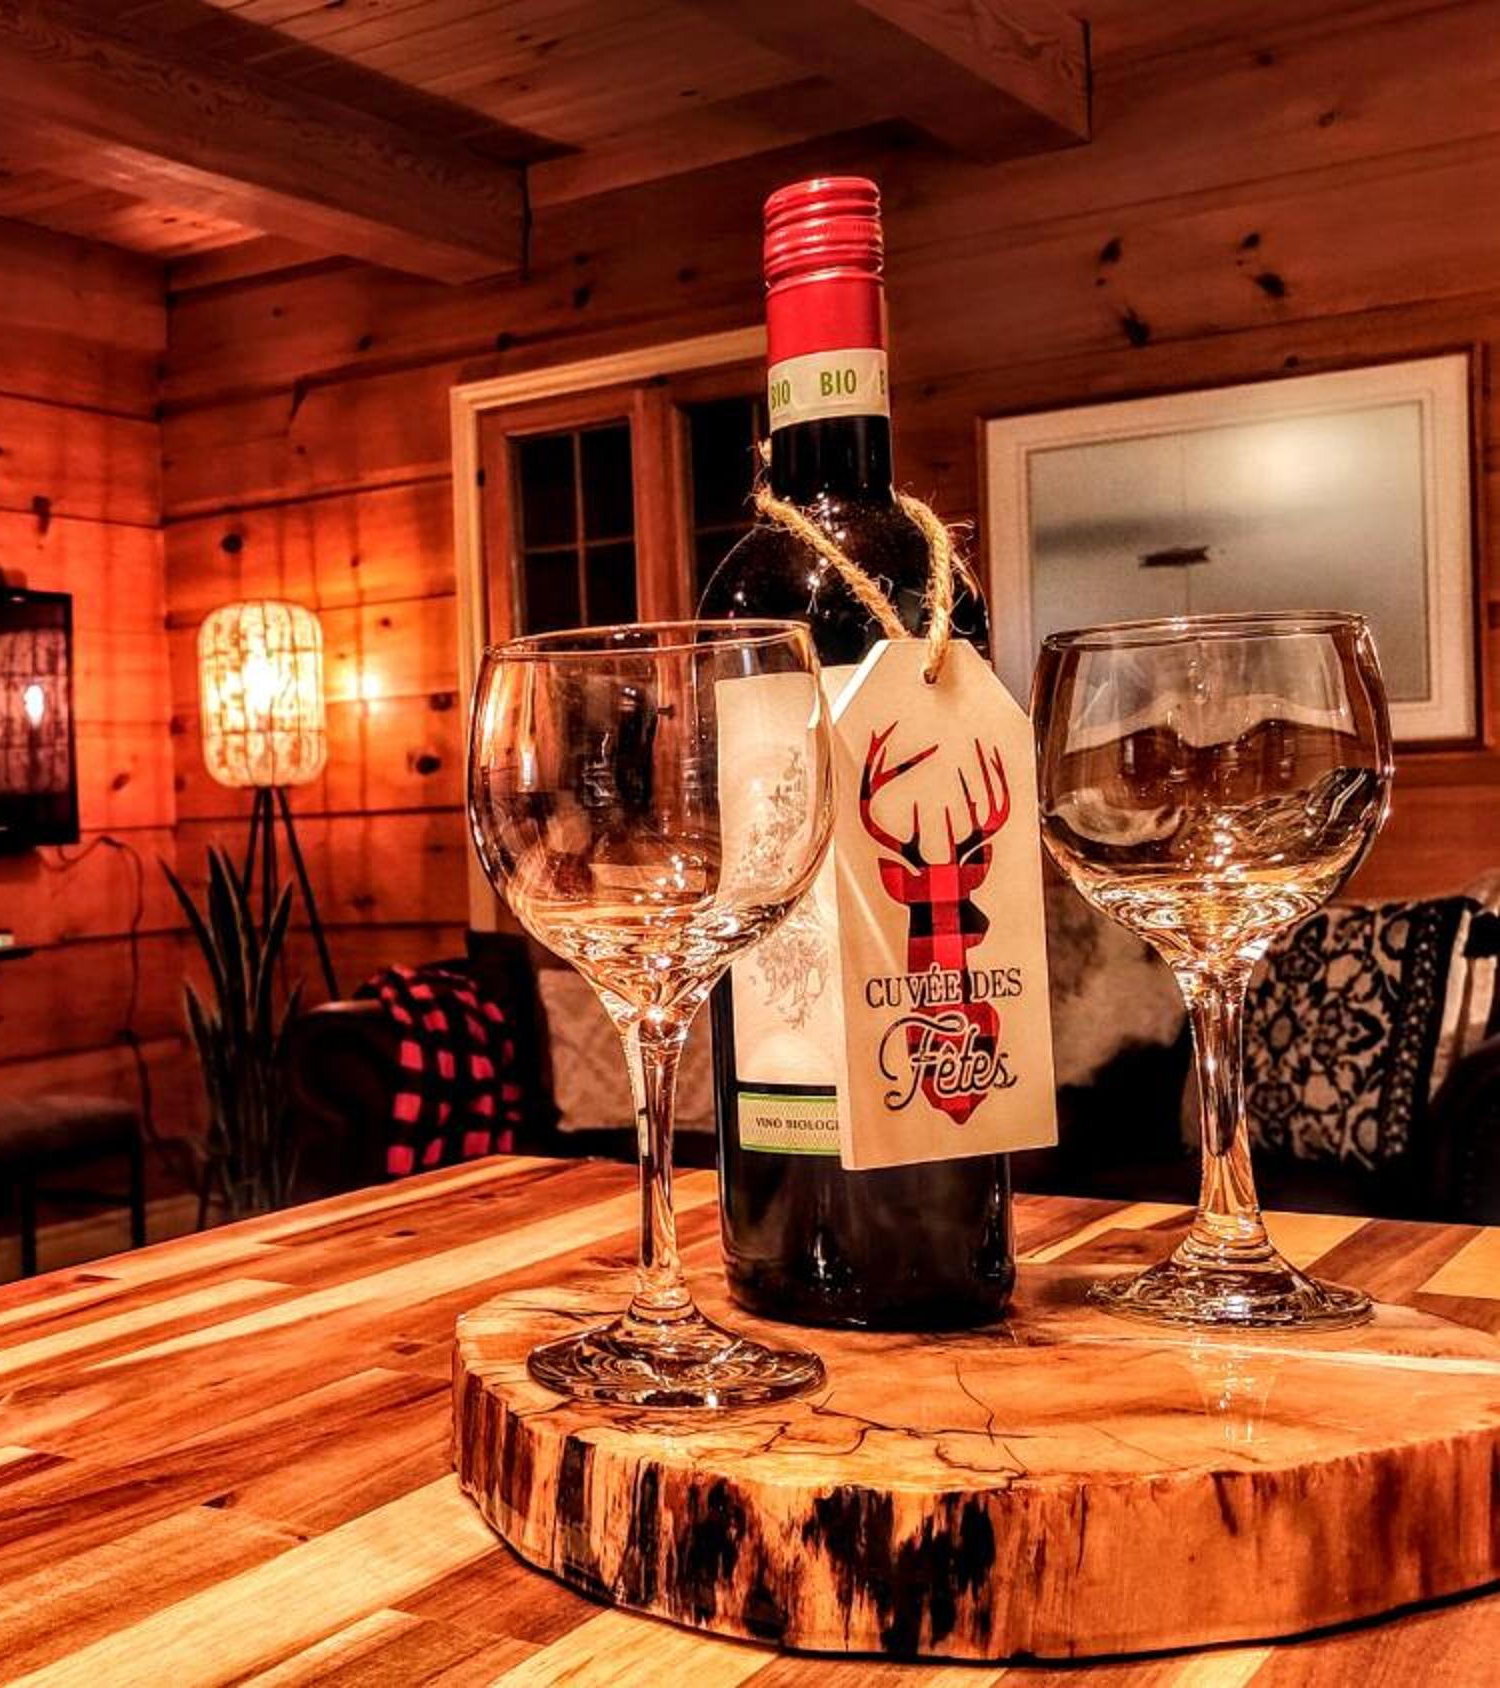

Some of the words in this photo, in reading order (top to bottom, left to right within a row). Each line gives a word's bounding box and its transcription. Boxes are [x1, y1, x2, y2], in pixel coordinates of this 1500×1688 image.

[771, 379, 791, 411] BIO
[820, 368, 857, 397] BIO
[865, 965, 961, 1009] CUVÉE
[972, 967, 1023, 999] DES
[879, 1013, 1018, 1111] Fêtes
[755, 1117, 782, 1129] VINO
